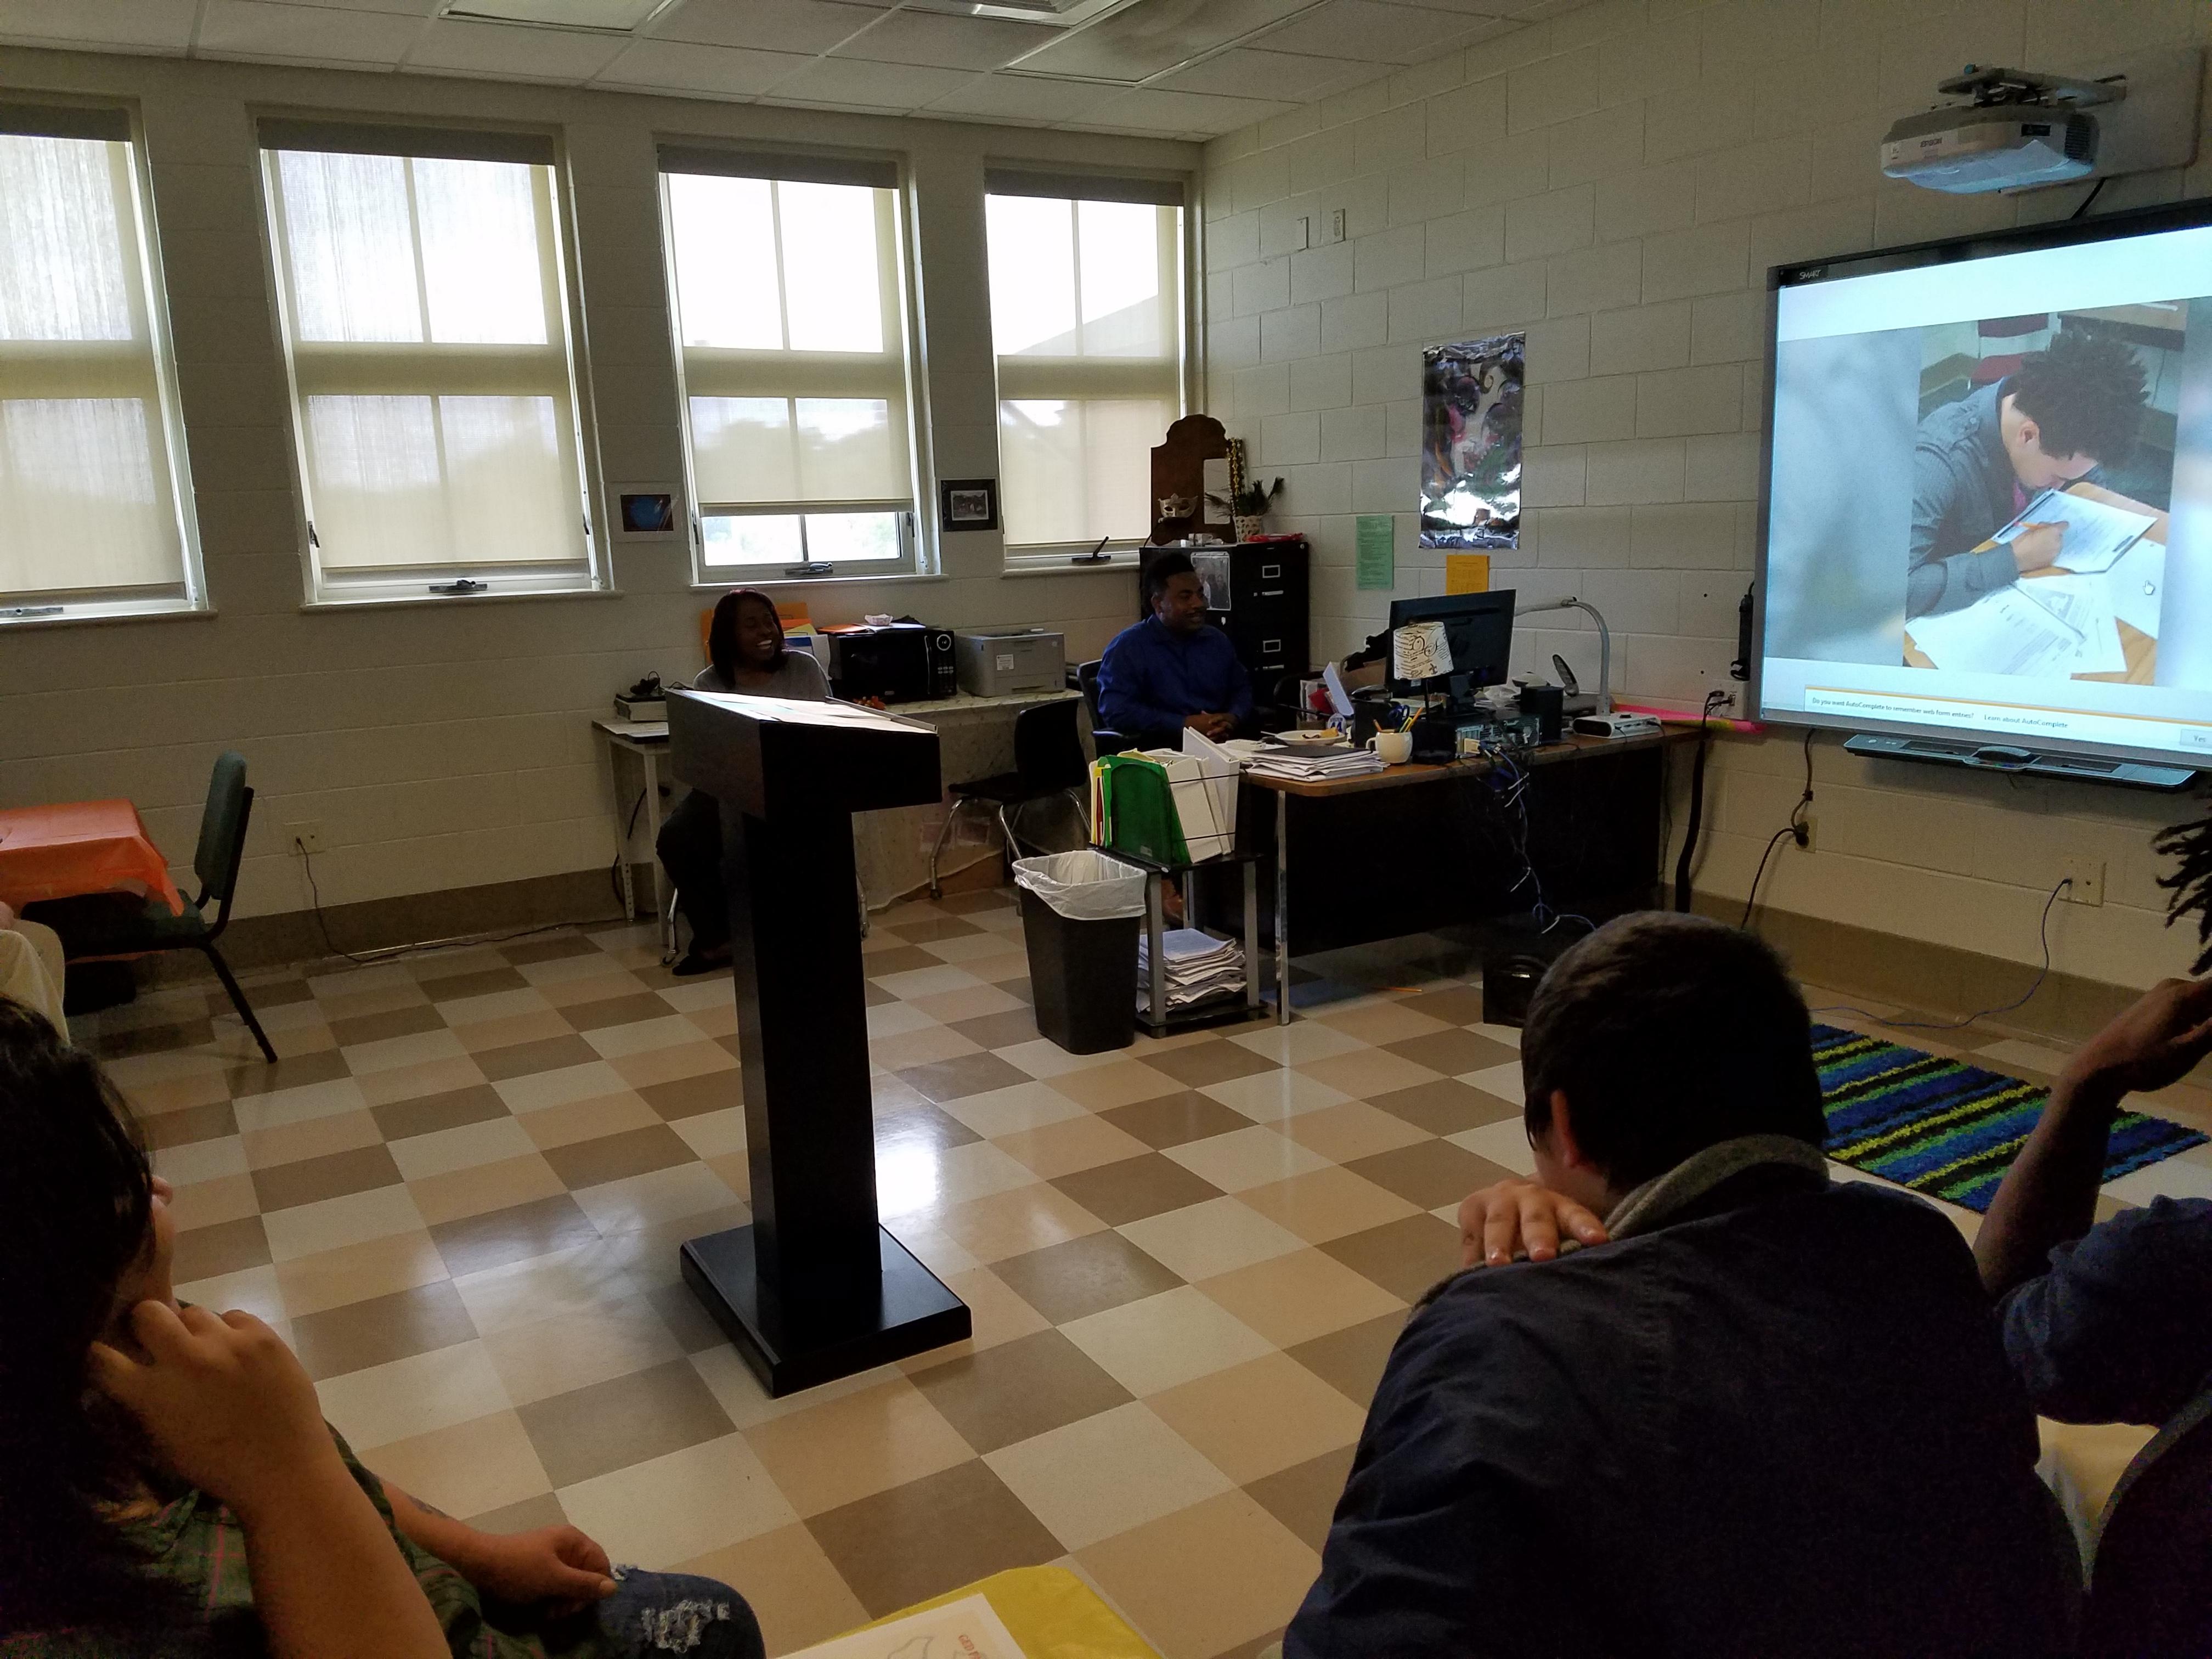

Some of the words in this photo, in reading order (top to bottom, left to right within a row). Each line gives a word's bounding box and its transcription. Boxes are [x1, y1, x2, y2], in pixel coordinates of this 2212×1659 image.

[1921, 138, 1943, 147] EPSON
[1799, 269, 1821, 279] SMART
[1846, 701, 1885, 710] AutoComplete
[2022, 719, 2068, 728] AutoComplete
[958, 1634, 974, 1651] GED
